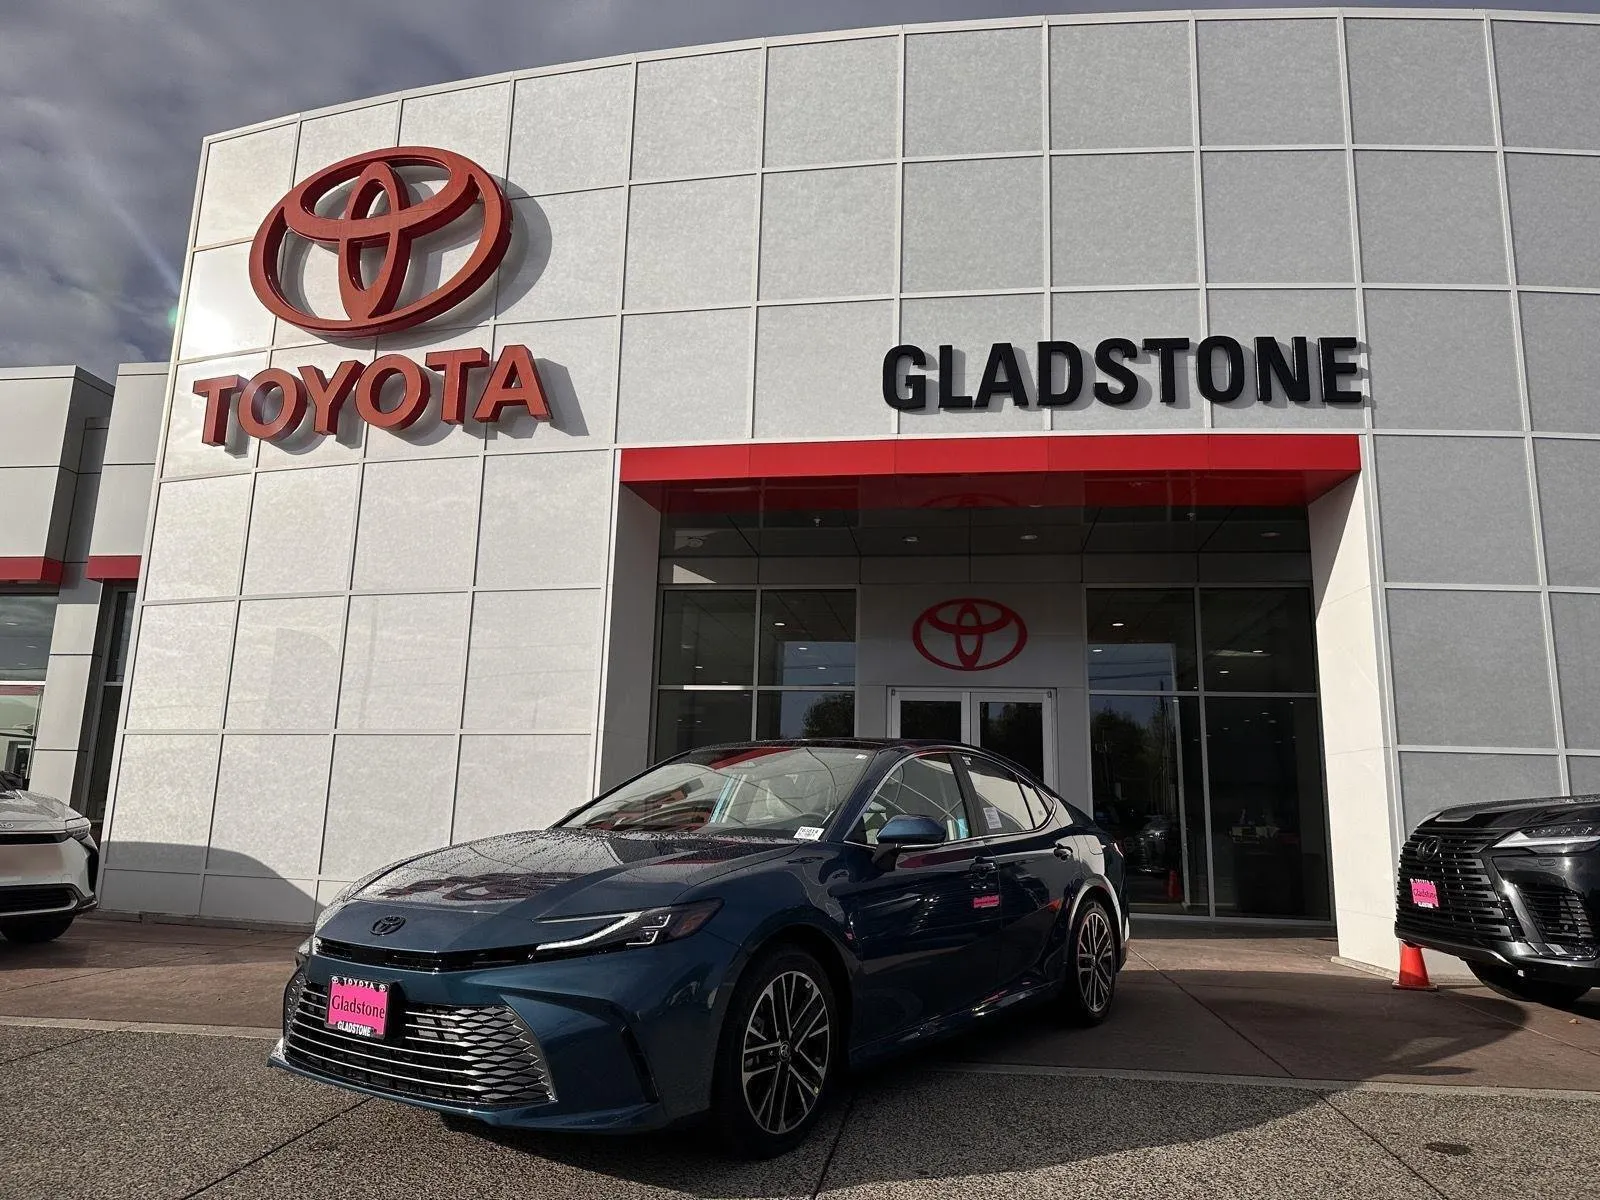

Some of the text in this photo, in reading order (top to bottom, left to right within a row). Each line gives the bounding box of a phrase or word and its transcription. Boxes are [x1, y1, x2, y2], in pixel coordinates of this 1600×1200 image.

[882, 335, 1364, 410] GLADSTONE
[192, 344, 552, 446] TOYOTA
[342, 977, 375, 989] TOYOTA
[331, 994, 385, 1019] Gladstone
[337, 1020, 371, 1036] GLADSTONE
